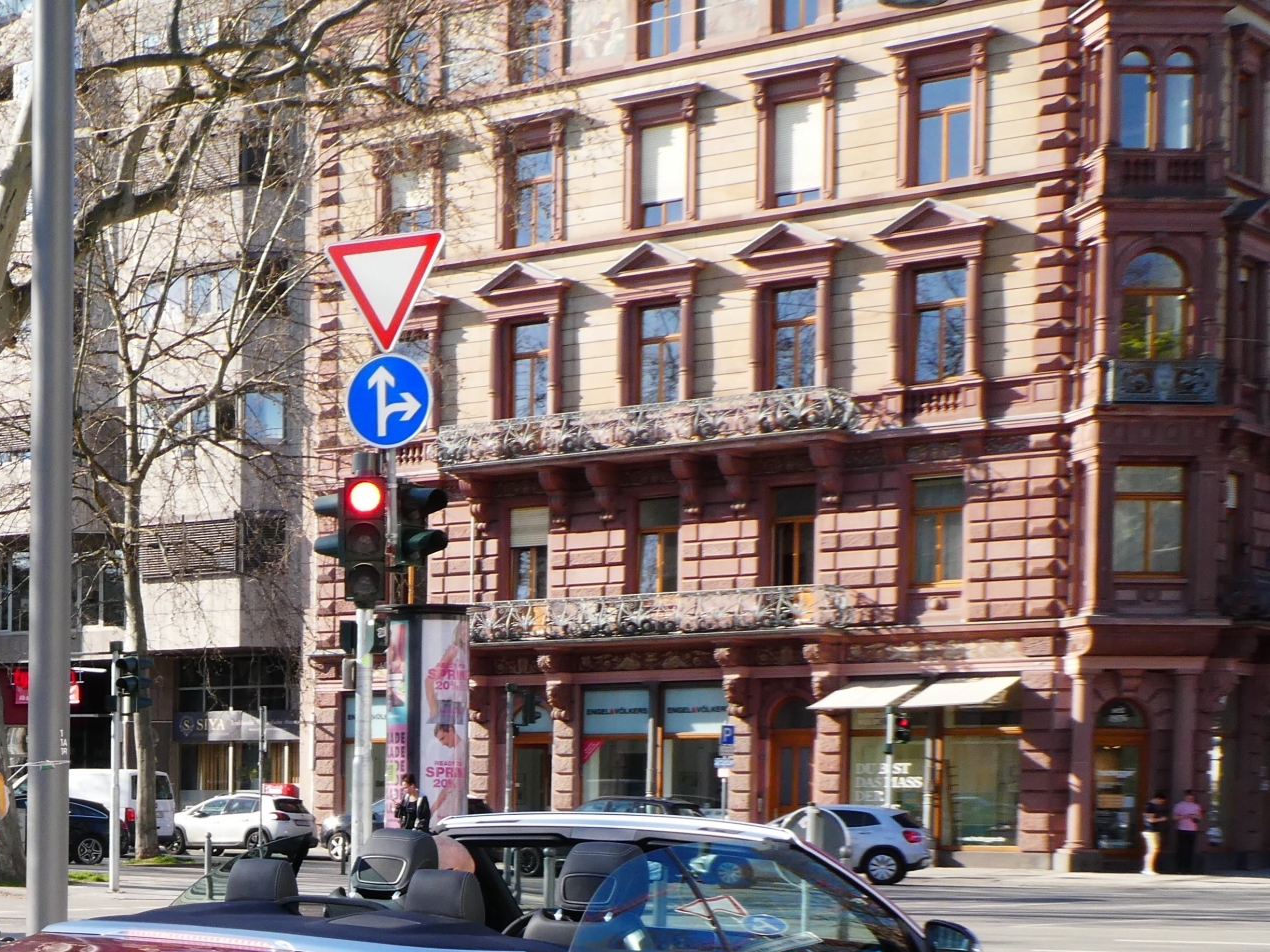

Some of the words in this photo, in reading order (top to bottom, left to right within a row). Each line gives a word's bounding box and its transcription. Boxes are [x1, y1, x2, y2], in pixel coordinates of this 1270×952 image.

[197, 718, 226, 731] SIYA
[723, 727, 732, 742] P
[855, 777, 882, 788] DAS
